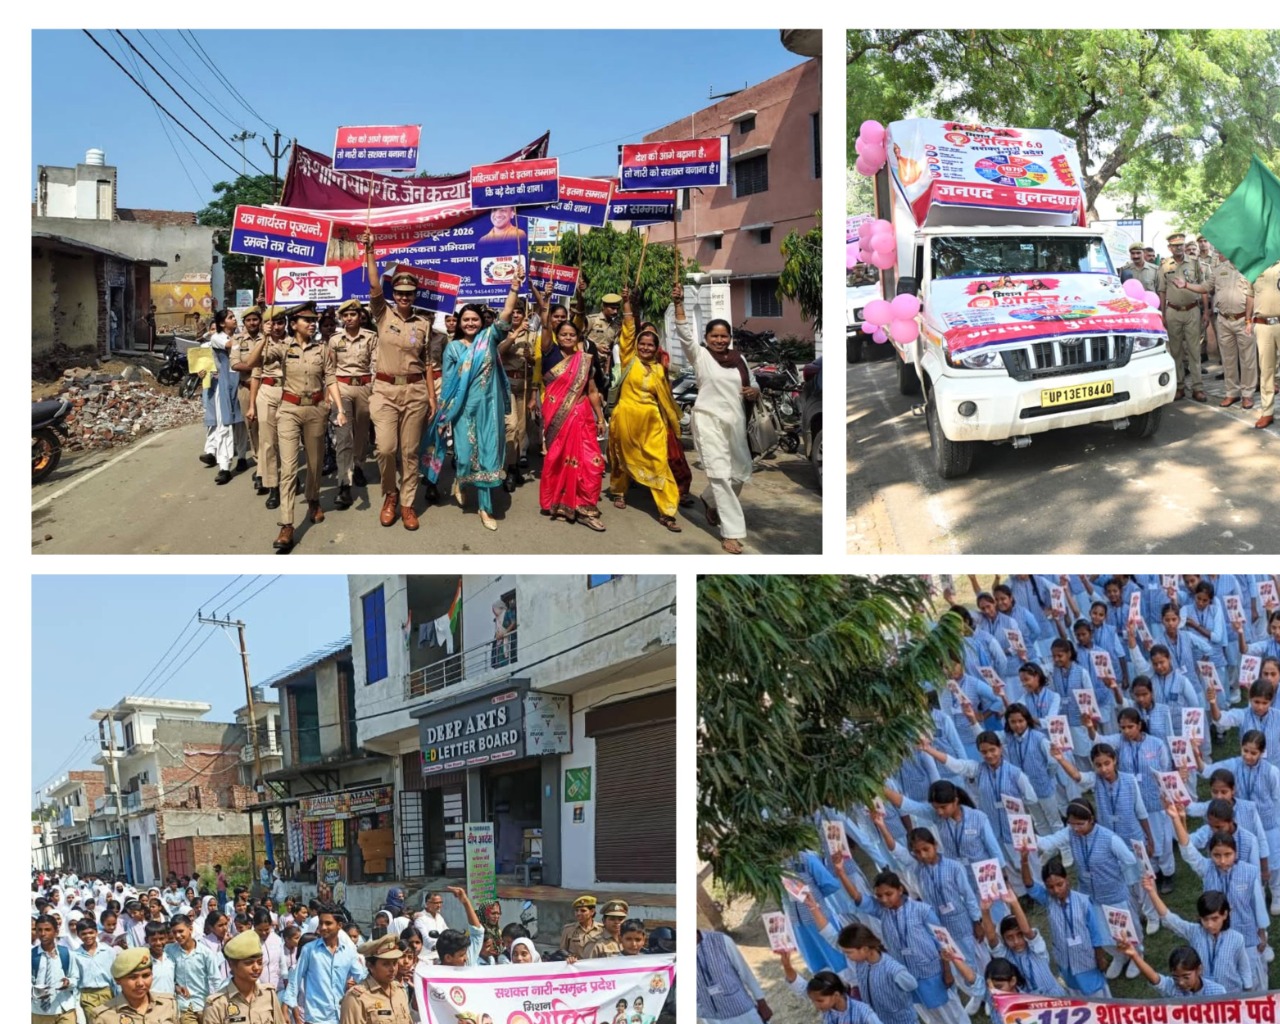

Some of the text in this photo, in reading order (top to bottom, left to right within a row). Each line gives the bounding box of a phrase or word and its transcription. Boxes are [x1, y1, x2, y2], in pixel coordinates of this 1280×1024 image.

[633, 166, 647, 178] नारी
[938, 185, 994, 200] जनपद
[240, 212, 255, 224] यत्र
[453, 228, 474, 236] 2026
[243, 234, 270, 248] रमन्ते
[1050, 383, 1112, 402] UP13ET8440
[427, 720, 462, 744] DEEP
[466, 706, 506, 735] ARTS
[438, 739, 476, 760] LETTER
[478, 729, 518, 751] BOARD
[495, 979, 616, 999] सशक्त प्रदेश
[523, 1000, 551, 1012] मिशन
[1245, 994, 1276, 1024] पर्व
